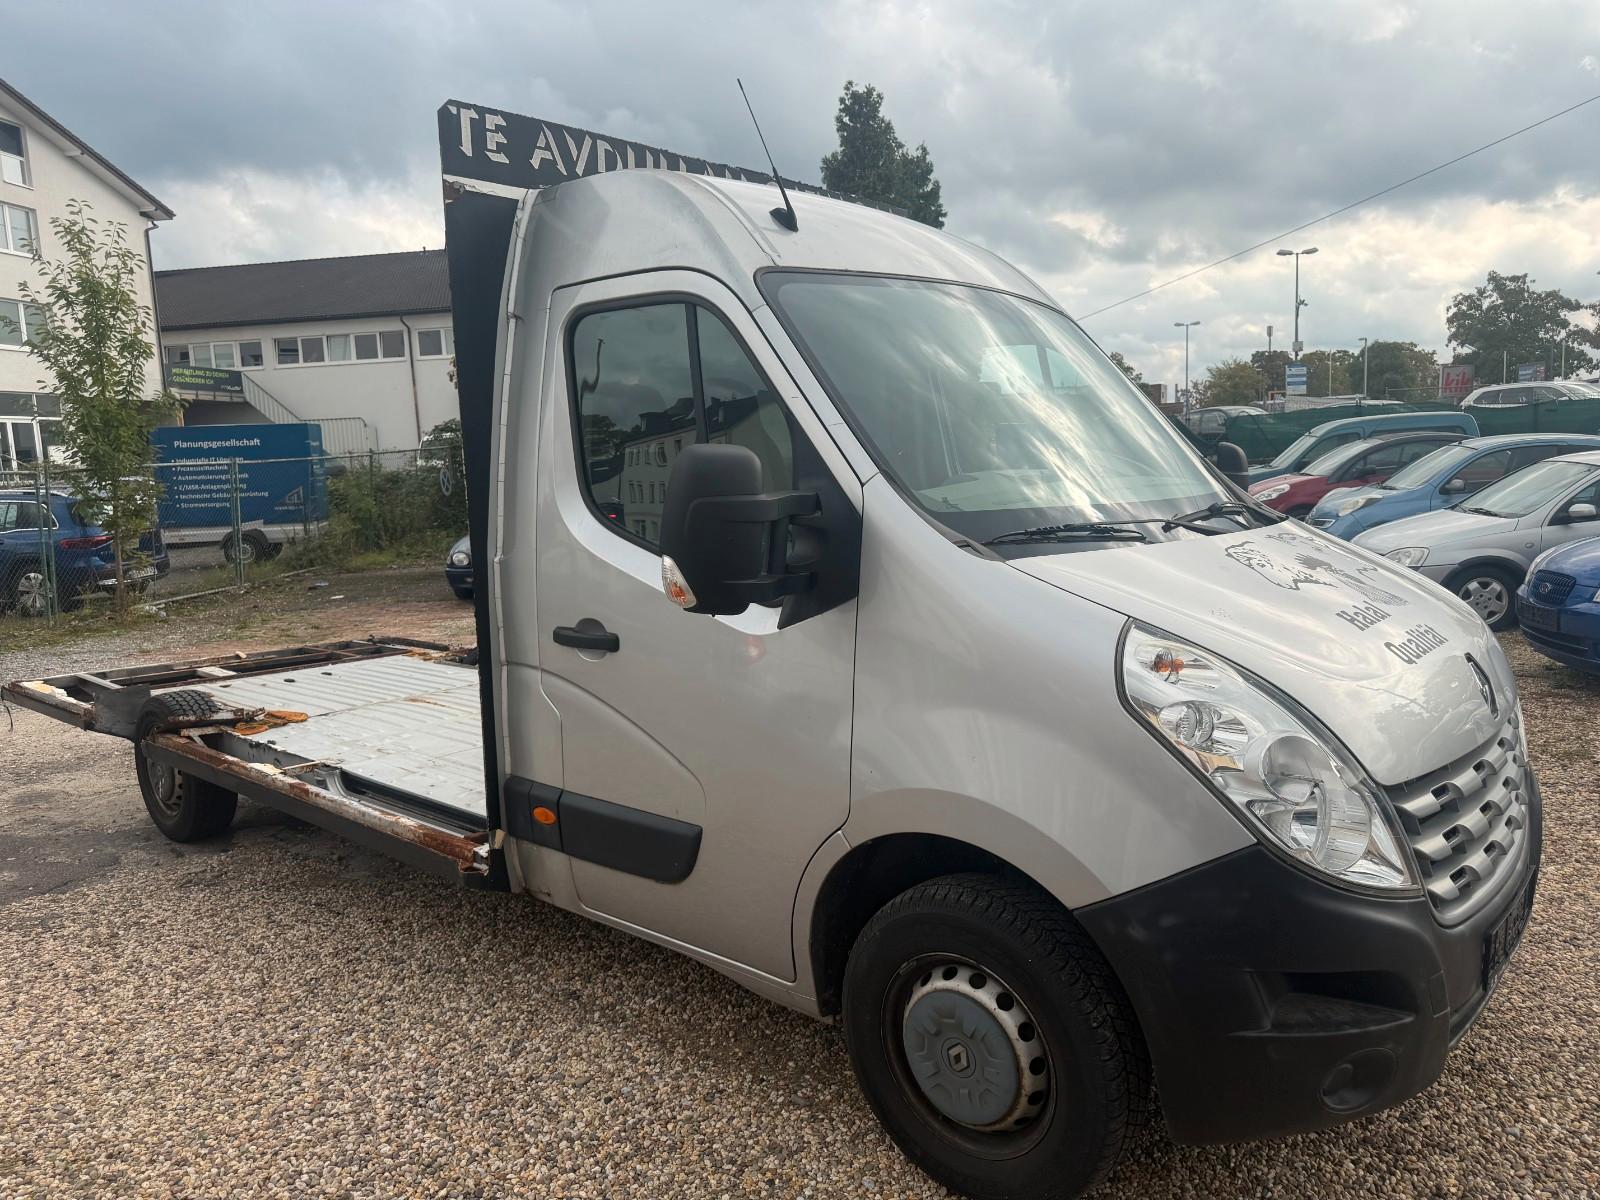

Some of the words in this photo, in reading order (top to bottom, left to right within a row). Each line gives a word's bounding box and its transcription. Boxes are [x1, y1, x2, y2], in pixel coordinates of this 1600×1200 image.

[447, 104, 510, 164] TE
[173, 438, 261, 449] Planungsgesellschaft
[1336, 600, 1392, 631] Halal
[1384, 624, 1448, 664] Qualität
